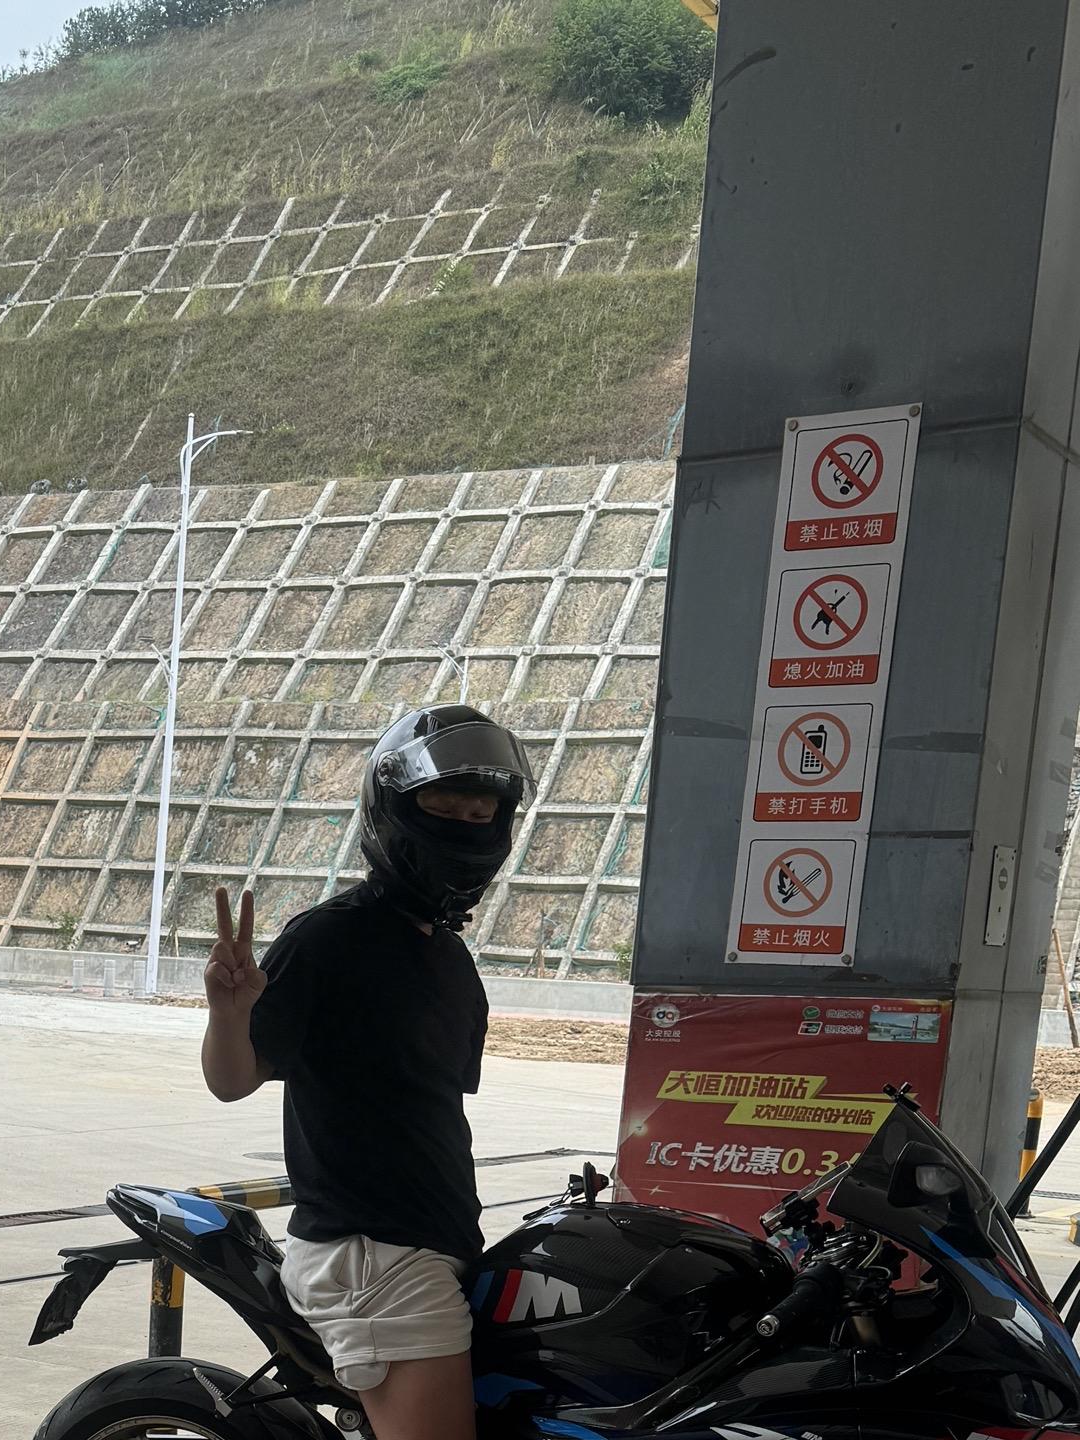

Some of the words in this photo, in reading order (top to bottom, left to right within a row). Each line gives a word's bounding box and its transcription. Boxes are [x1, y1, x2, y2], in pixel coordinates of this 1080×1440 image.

[799, 518, 883, 543] 禁止吸烟
[782, 659, 865, 681] 熄火加油
[767, 796, 849, 815] 禁打手机
[752, 927, 831, 948] 禁止烟火
[664, 1072, 810, 1100] 大恒加油站
[752, 1104, 875, 1126] 欢迎您的光临
[508, 1270, 583, 1322] M
